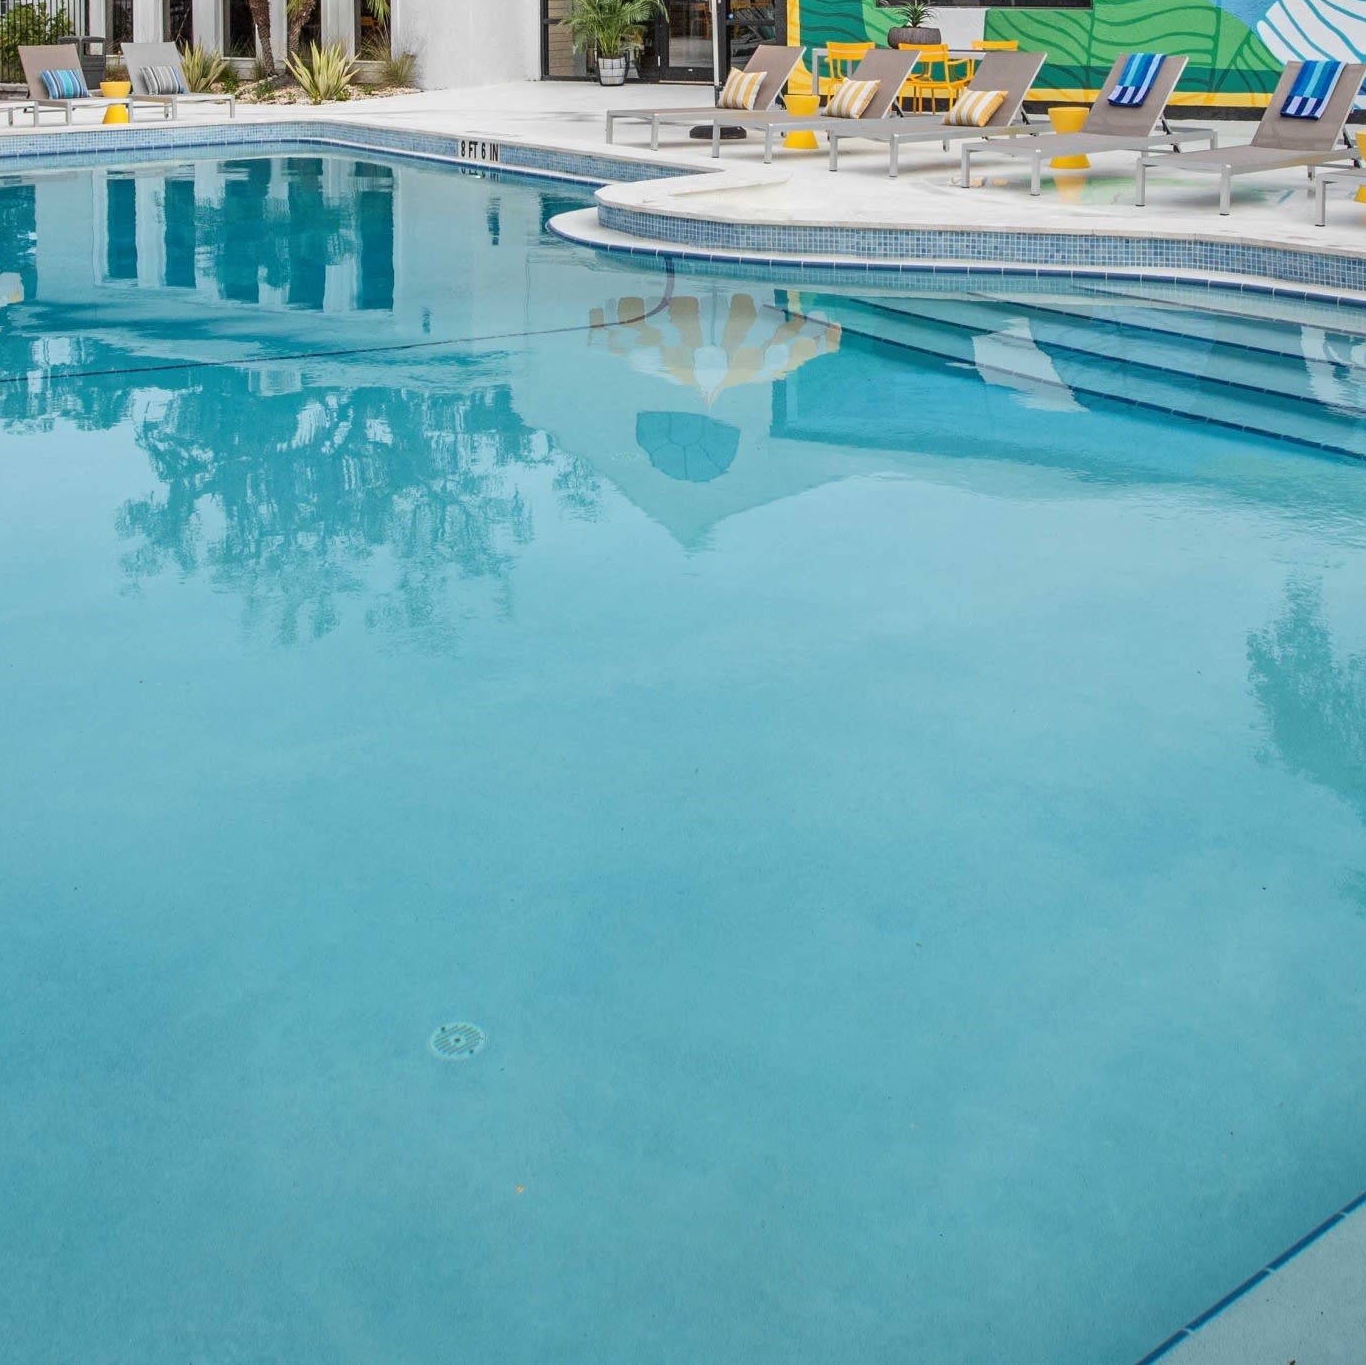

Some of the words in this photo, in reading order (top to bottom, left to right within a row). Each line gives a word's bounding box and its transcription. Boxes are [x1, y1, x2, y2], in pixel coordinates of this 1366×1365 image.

[461, 140, 466, 157] 8
[468, 140, 478, 159] FT
[481, 142, 486, 160] 6
[489, 143, 499, 162] IN
